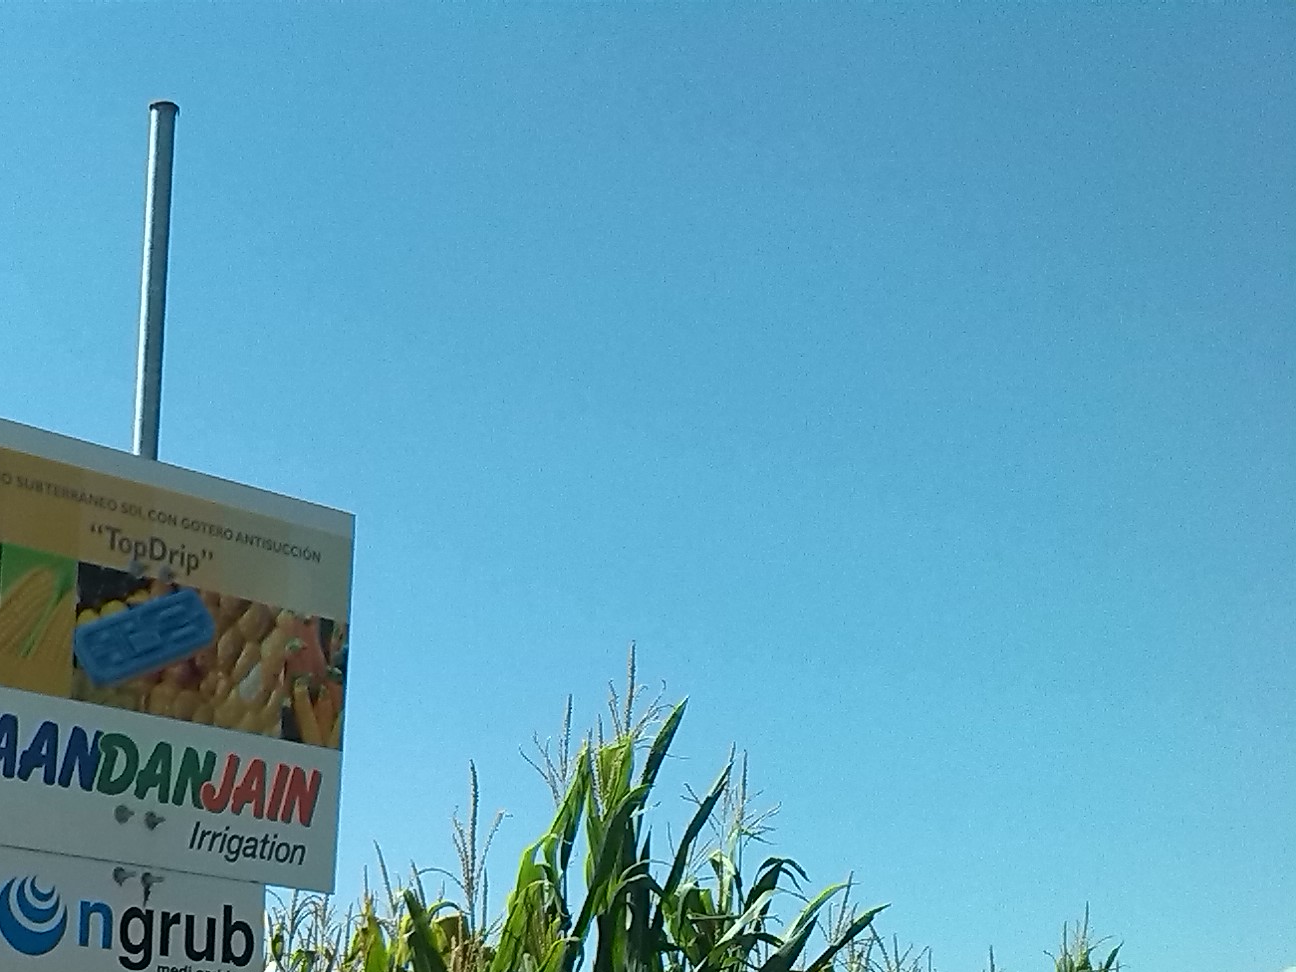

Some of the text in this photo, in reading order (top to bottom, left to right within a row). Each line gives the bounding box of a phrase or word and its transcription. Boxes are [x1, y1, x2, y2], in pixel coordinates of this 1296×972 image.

[147, 509, 178, 528] CON
[181, 517, 234, 541] GOTERO
[235, 531, 322, 563] ANTISUCCIÓN
[188, 821, 307, 866] Irrigation
